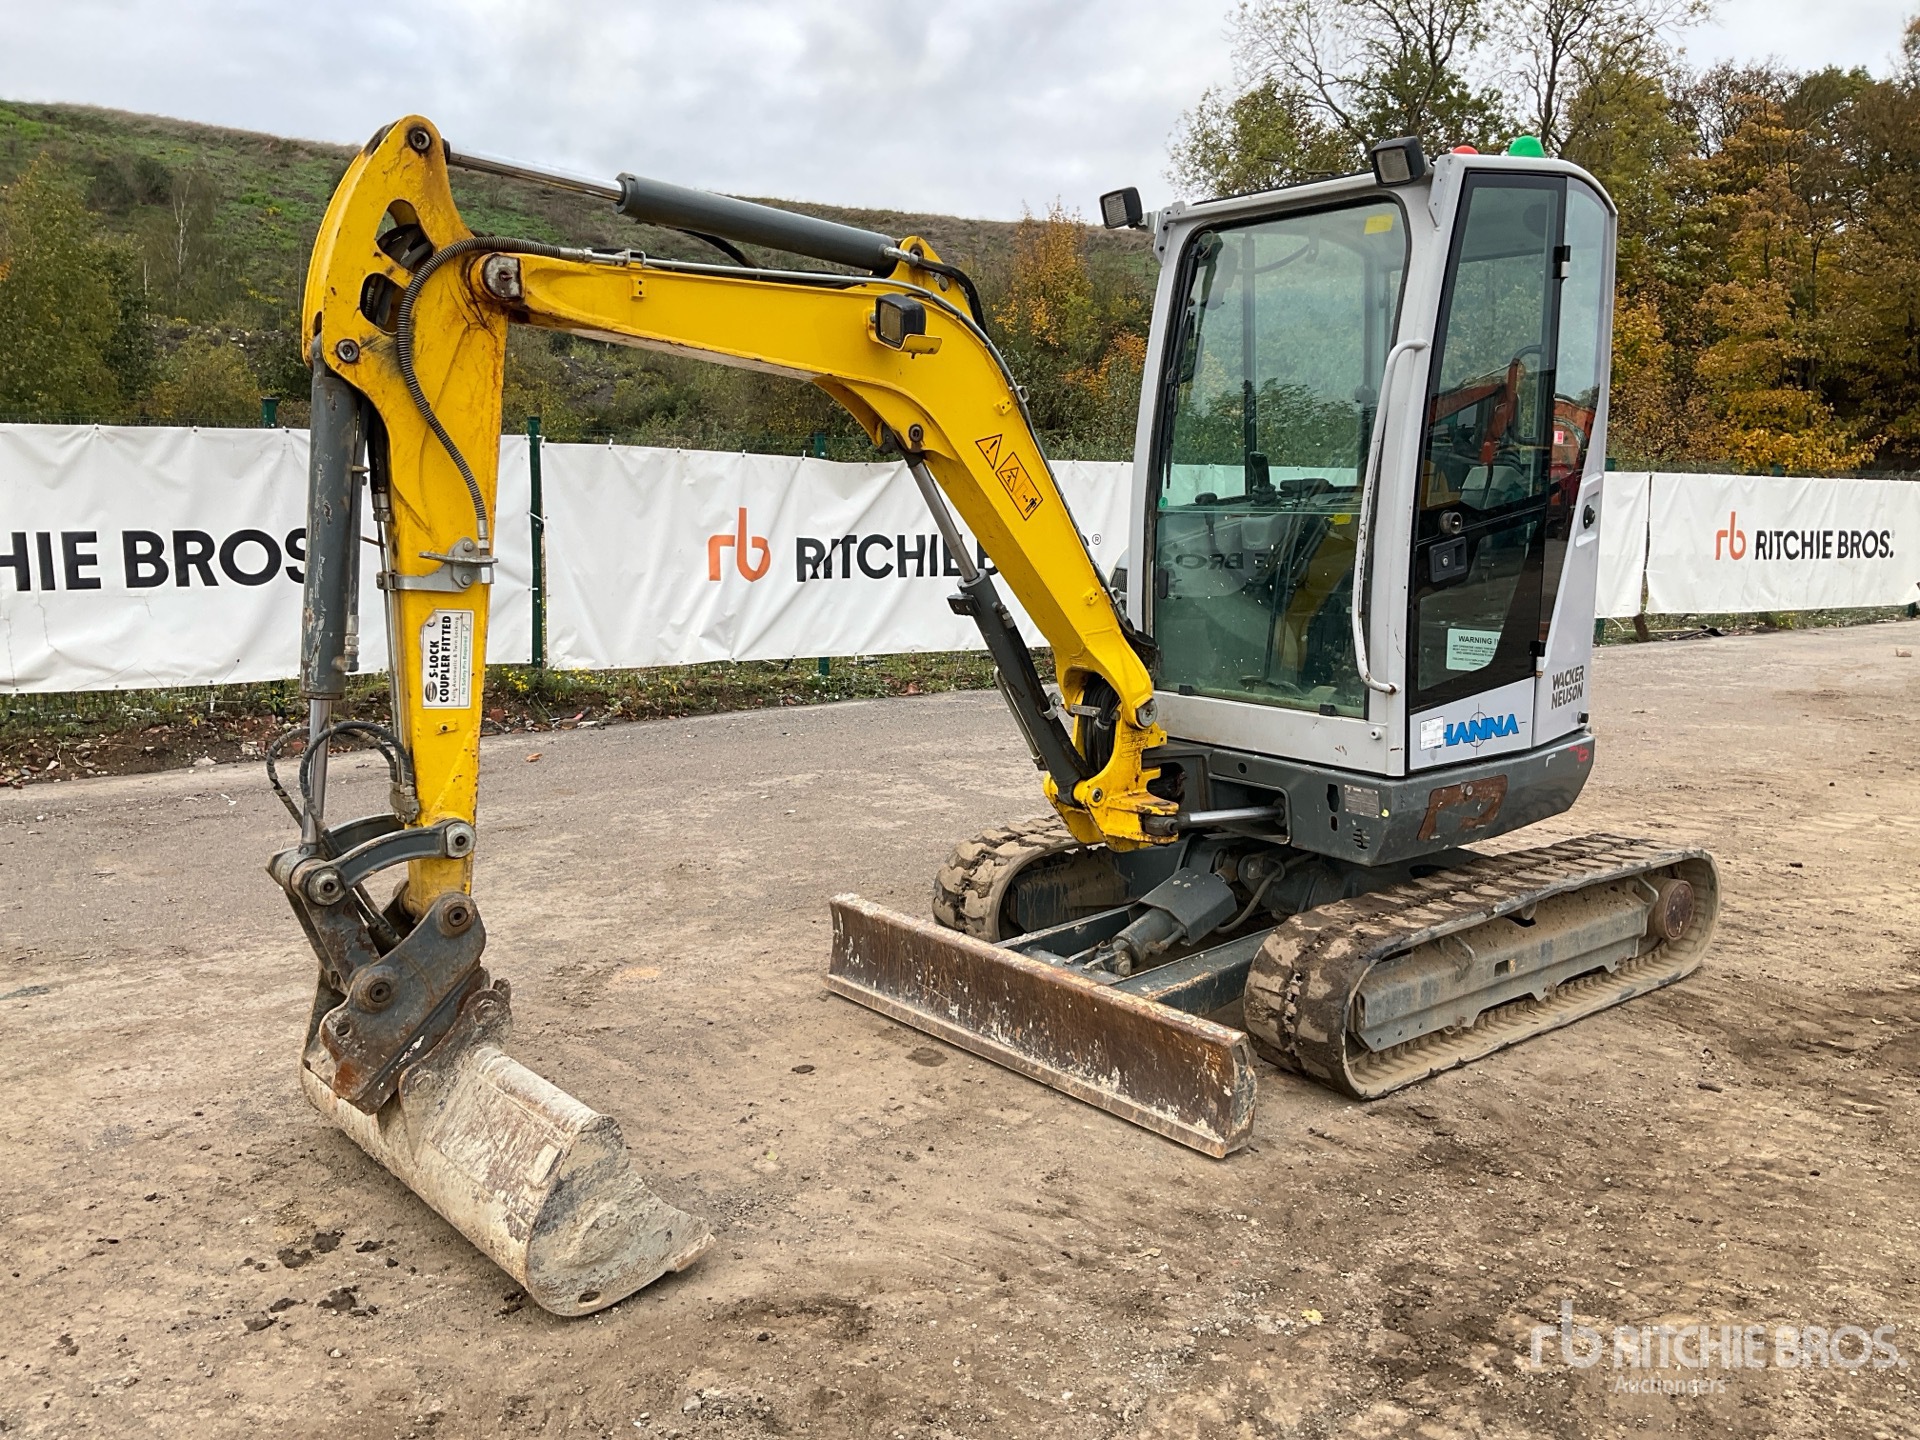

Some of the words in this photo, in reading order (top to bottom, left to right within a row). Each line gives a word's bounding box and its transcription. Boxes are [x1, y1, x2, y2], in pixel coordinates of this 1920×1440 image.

[1755, 530, 1833, 560] RITCHIE
[441, 615, 452, 652] FITTED
[1458, 635, 1493, 645] WARNING
[439, 654, 451, 703] COUPLER
[1552, 665, 1584, 691] WACKER
[1551, 682, 1583, 710] NEUSON
